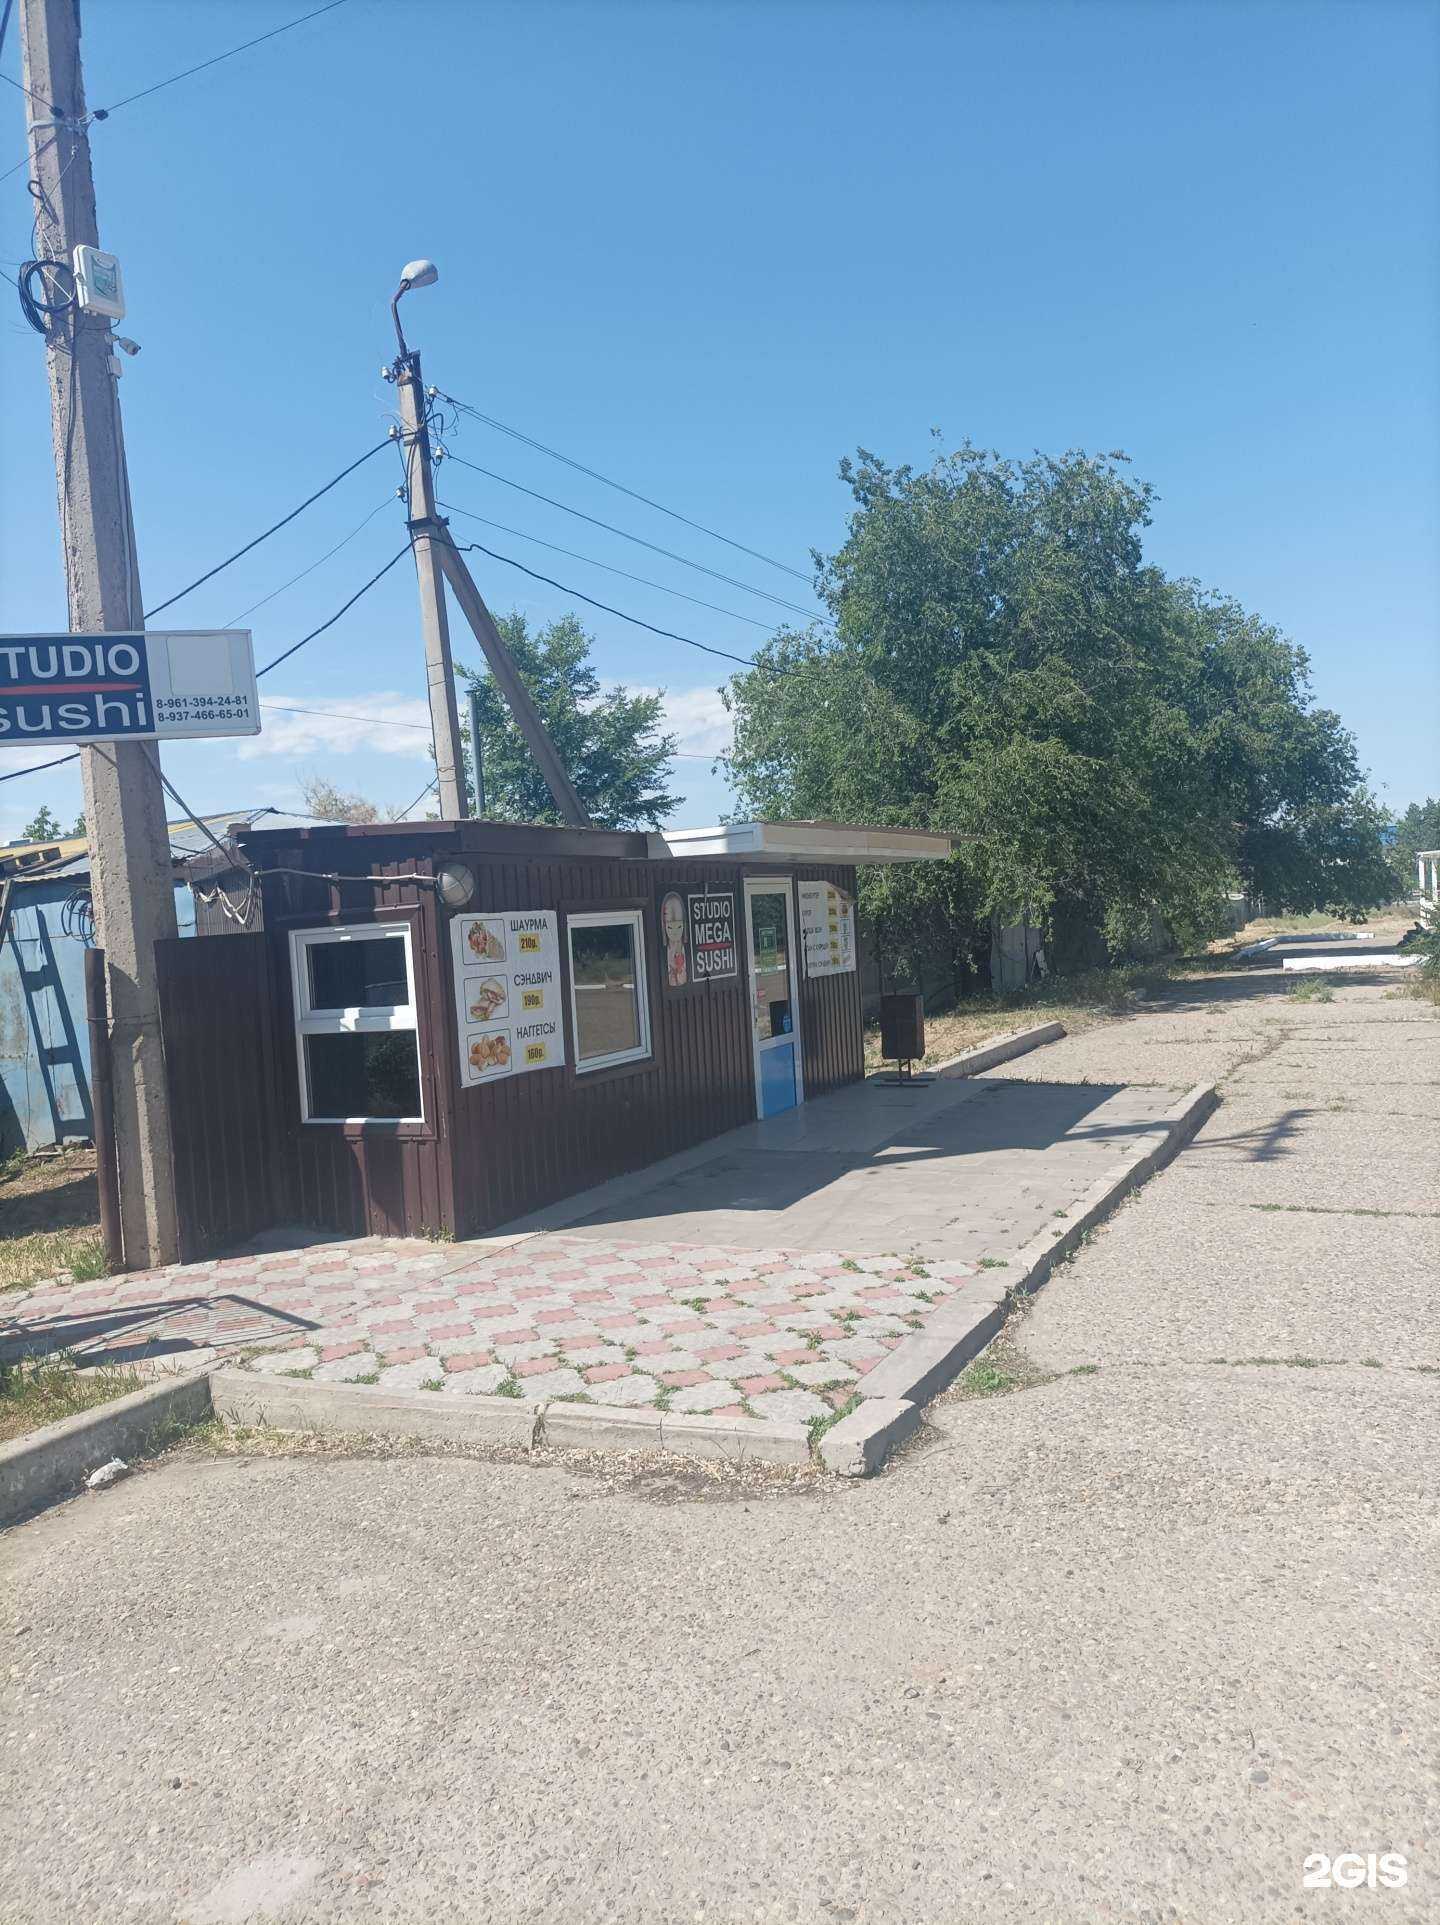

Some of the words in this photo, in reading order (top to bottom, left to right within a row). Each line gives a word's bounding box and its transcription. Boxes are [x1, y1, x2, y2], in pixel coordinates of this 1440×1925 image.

[156, 695, 248, 709] 8-961-394-24-81
[158, 708, 250, 722] 8-937-466-65-01
[694, 901, 731, 920] STUDIO
[510, 918, 548, 932] ШАУРМА
[695, 921, 732, 944] MEGA
[696, 948, 733, 972] SUSHI
[513, 971, 553, 986] СЭНДВИЧ
[516, 1021, 556, 1039] НАГГЕТСЫ
